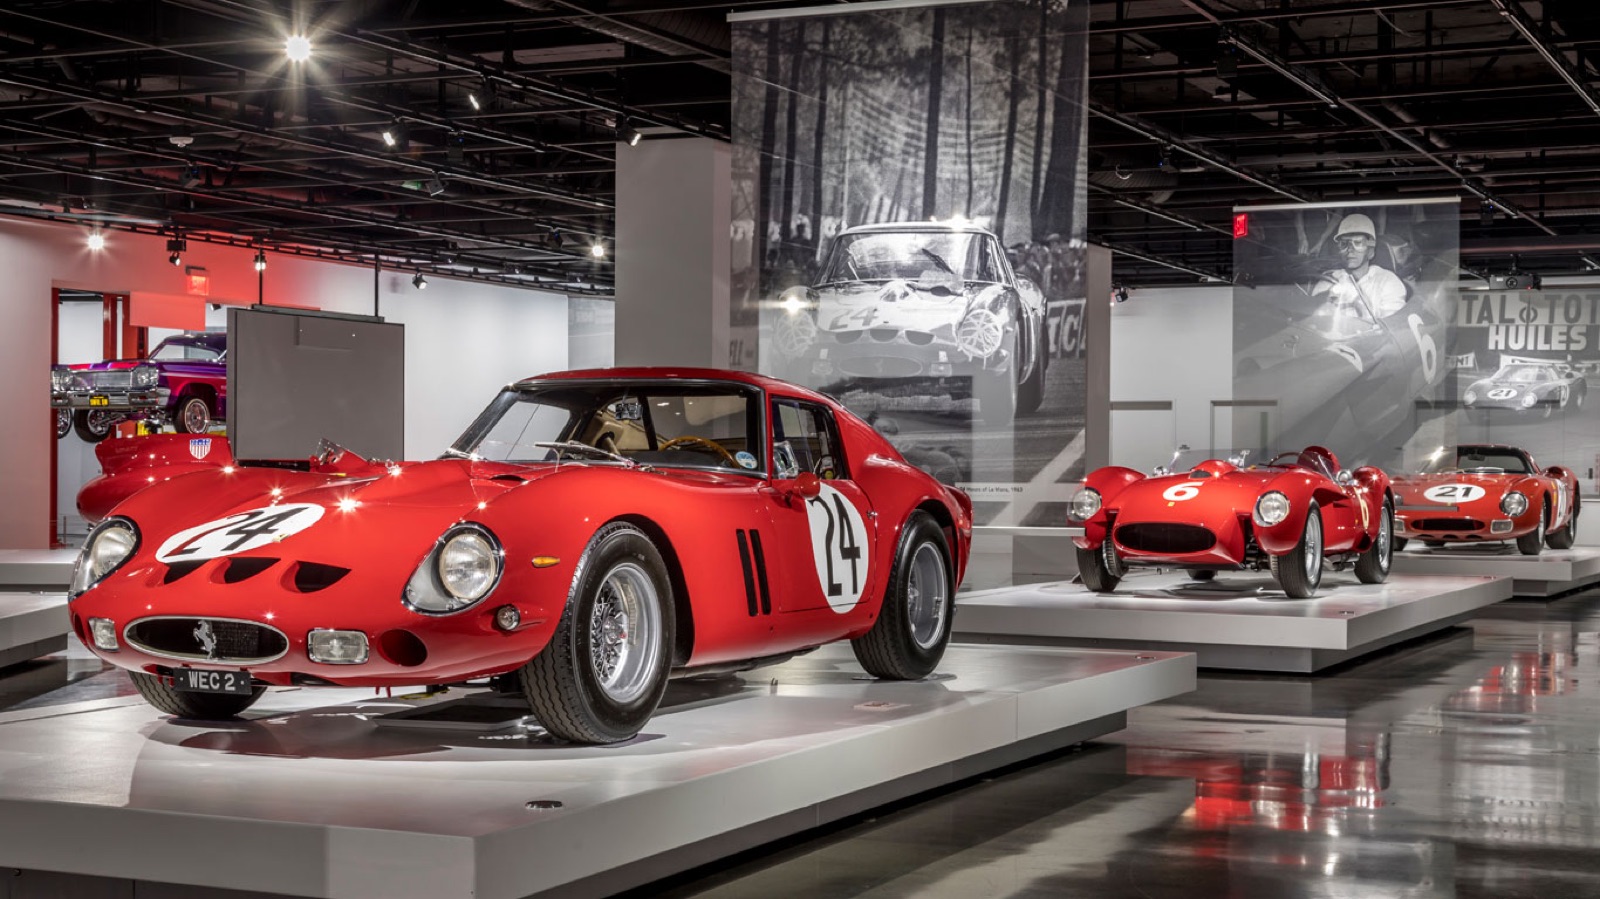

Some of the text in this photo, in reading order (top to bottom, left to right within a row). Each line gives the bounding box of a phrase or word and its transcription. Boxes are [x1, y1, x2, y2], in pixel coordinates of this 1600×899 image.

[829, 307, 879, 331] 24
[1408, 313, 1437, 384] 6
[1488, 325, 1587, 350] HUILES
[1495, 388, 1513, 398] 21
[1162, 481, 1205, 501] 6
[1435, 486, 1473, 497] 21
[162, 506, 310, 558] 24
[806, 493, 861, 597] 24
[188, 671, 236, 691] WEC 2
